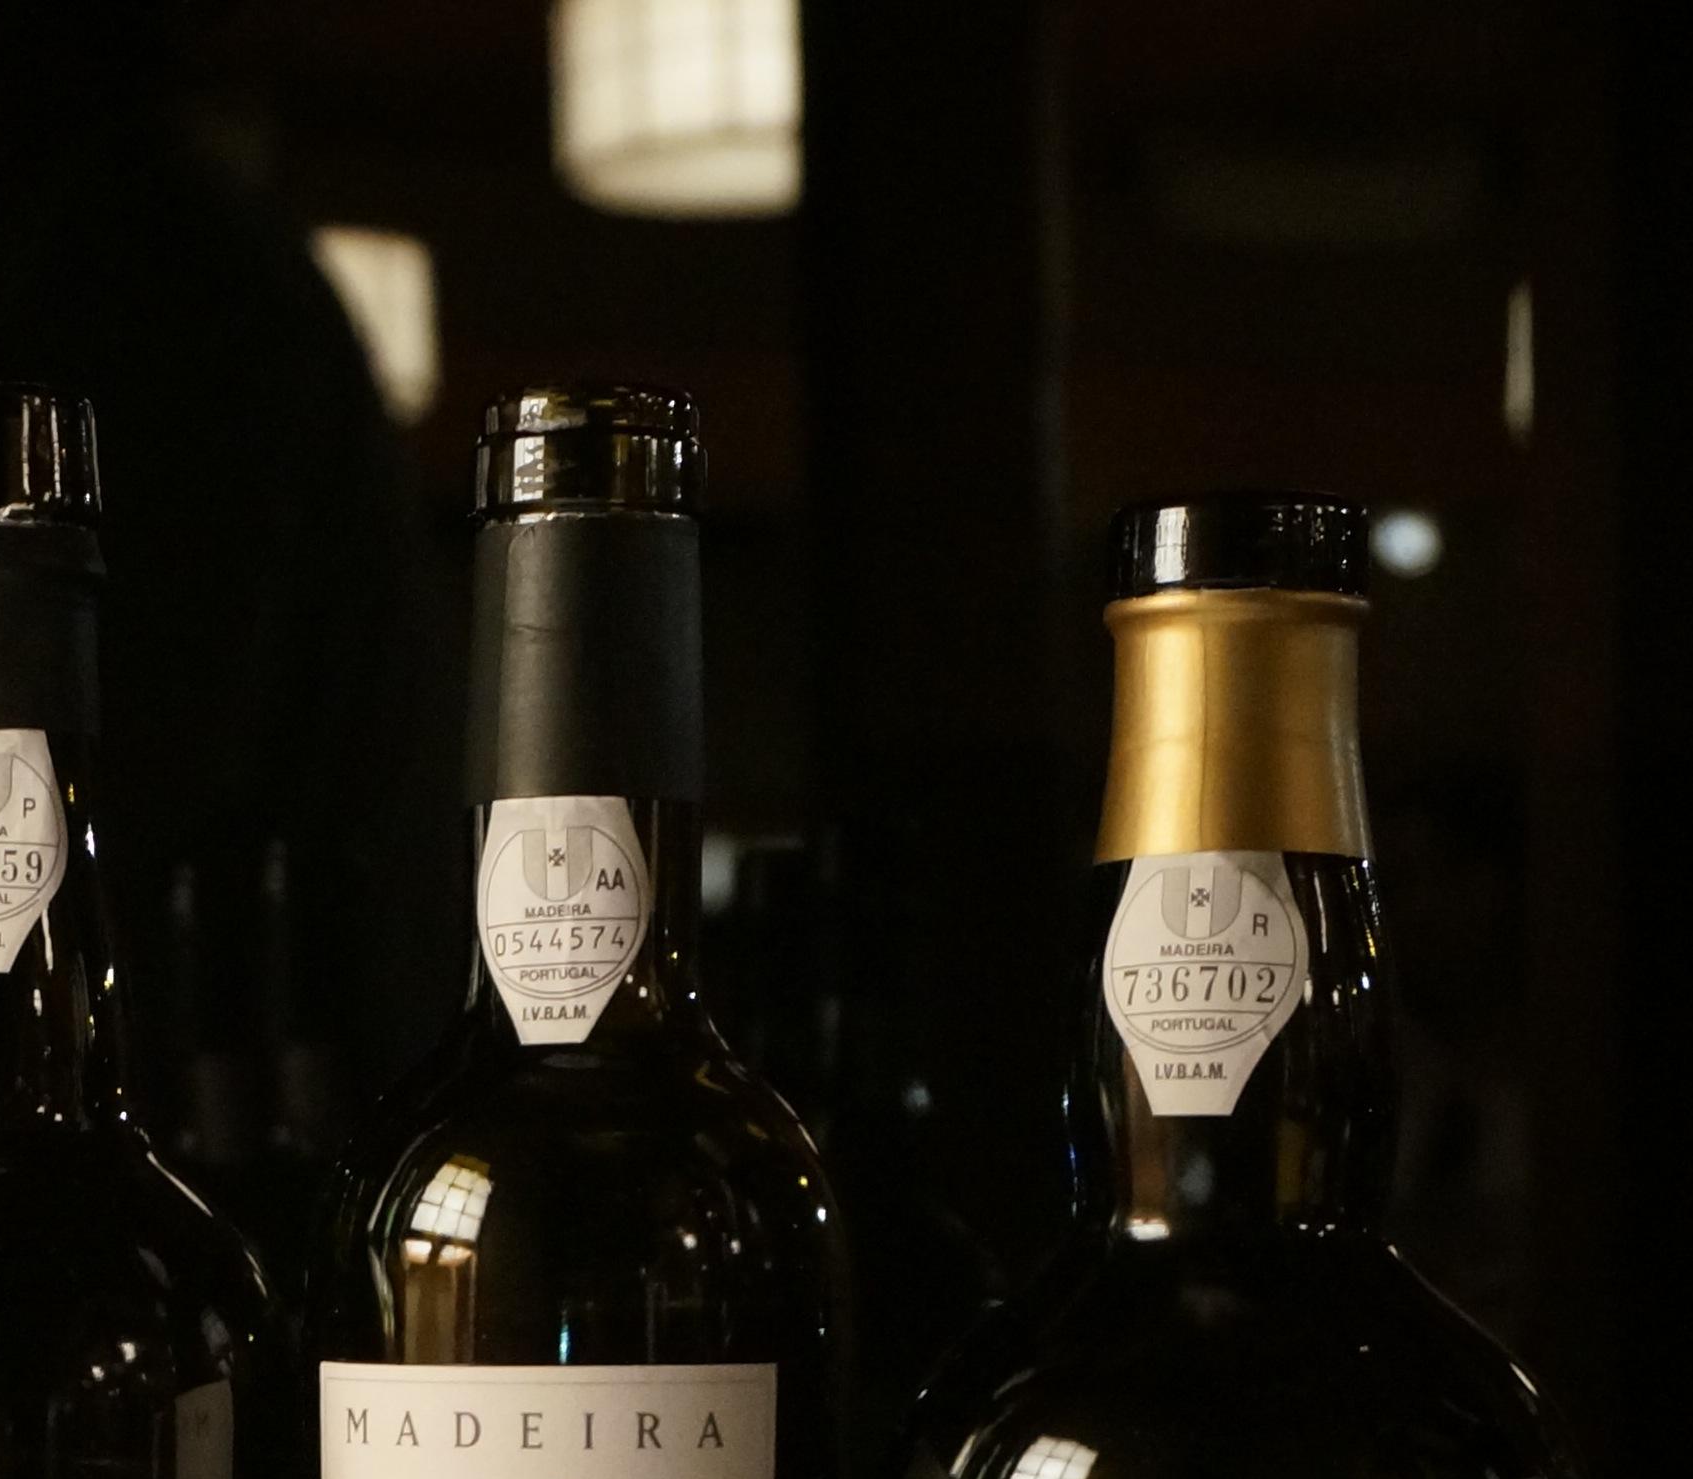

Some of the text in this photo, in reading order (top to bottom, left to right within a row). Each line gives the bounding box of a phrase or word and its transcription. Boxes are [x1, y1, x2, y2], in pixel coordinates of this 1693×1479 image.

[23, 798, 36, 818] P
[596, 868, 625, 892] AA
[525, 903, 592, 919] MADEIRA
[1252, 913, 1268, 936] R
[495, 926, 625, 957] 0544574
[1160, 943, 1234, 957] MADEIRA
[519, 967, 599, 982] PORTUGAL
[1123, 966, 1276, 1006] 736702
[1151, 1016, 1237, 1032] PORTUGAL
[346, 1408, 724, 1450] MADEIRA
